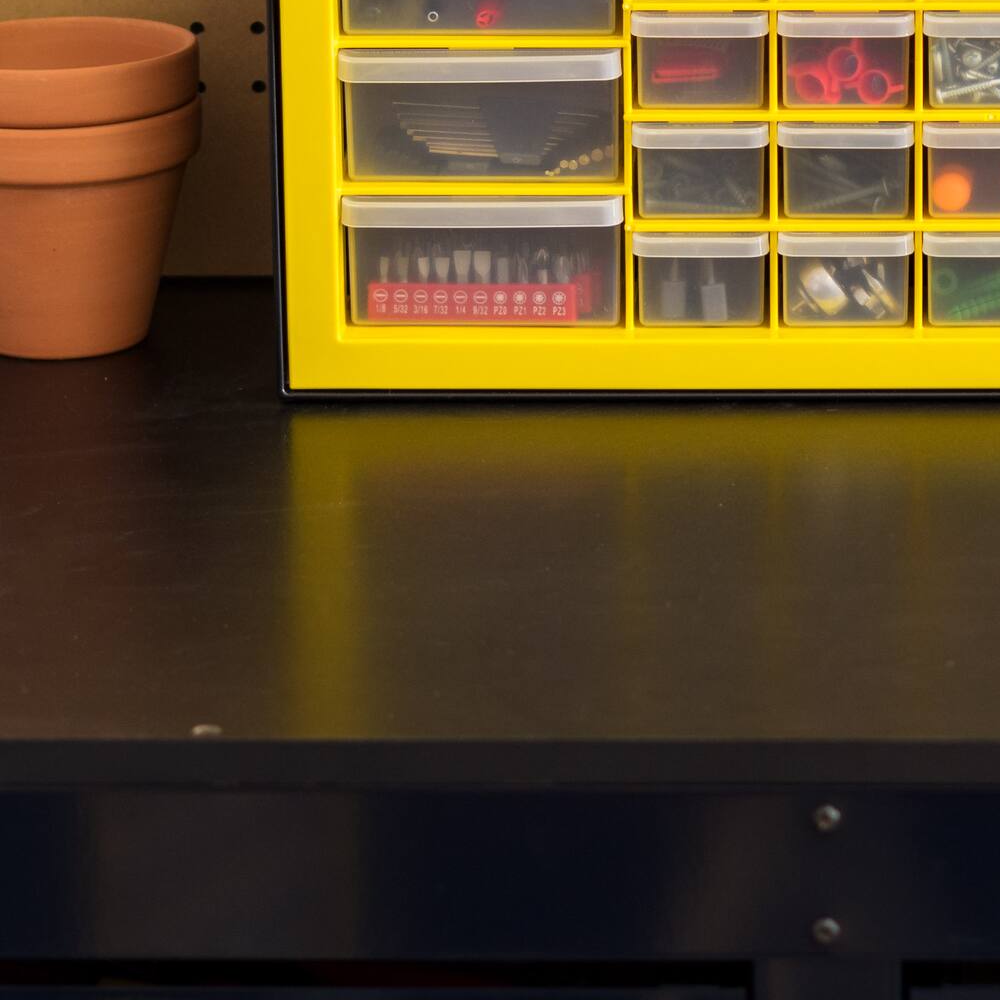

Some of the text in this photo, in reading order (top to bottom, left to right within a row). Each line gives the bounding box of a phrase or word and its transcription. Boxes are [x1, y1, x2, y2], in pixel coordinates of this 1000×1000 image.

[433, 304, 448, 315] 7/32
[456, 305, 466, 314] 1/4
[513, 306, 526, 316] PZ1
[533, 306, 546, 316] PZ2
[552, 306, 566, 316] PZ3
